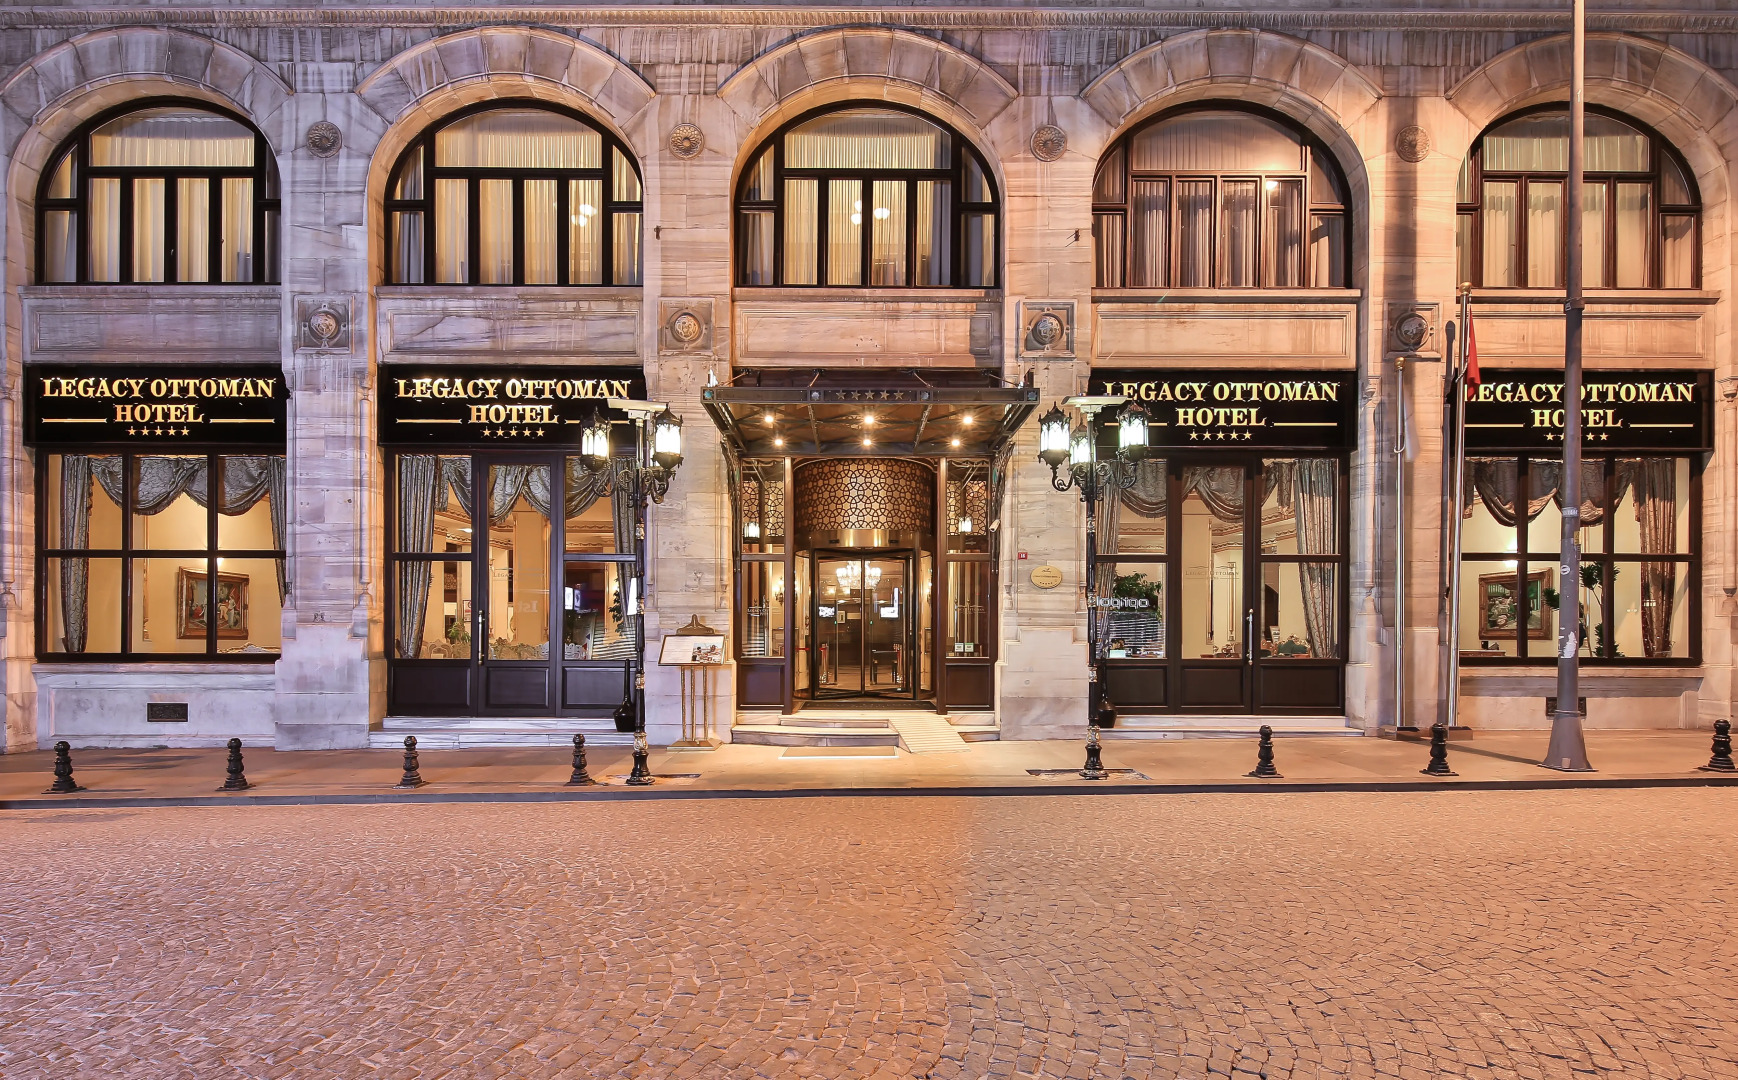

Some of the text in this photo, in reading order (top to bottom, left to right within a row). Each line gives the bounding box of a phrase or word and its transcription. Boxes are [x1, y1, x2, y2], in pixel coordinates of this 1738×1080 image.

[42, 378, 276, 398] LEGACY OTTOMAN
[396, 378, 632, 399] LEGACY OTTOMAN
[1104, 382, 1340, 401] LEGACY OTTOMAN
[1580, 383, 1697, 403] TTOMAN
[113, 403, 205, 423] HOTEL
[468, 403, 559, 424] HOTEL
[1175, 406, 1267, 427] HOTEL
[1531, 408, 1624, 428] HOEL
